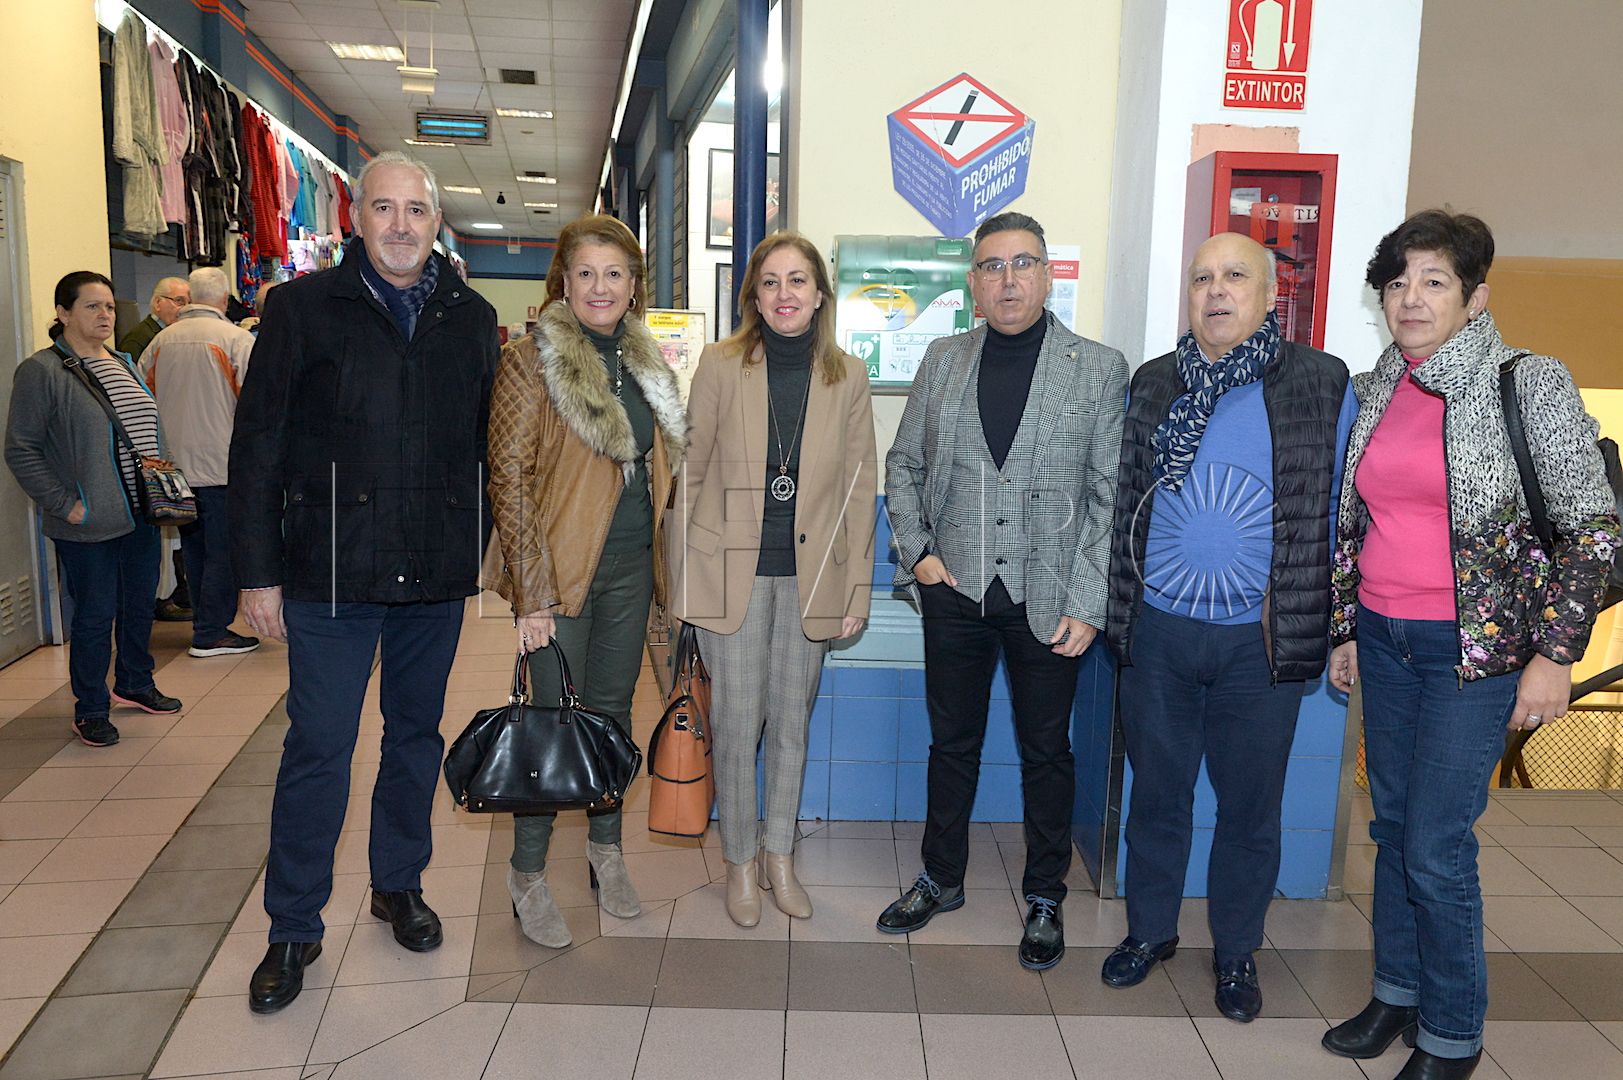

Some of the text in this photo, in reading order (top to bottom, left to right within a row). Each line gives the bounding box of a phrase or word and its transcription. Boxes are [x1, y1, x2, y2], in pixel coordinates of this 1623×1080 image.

[1225, 79, 1304, 103] EXTINTOR
[961, 135, 1031, 200] PROHIBIDO
[973, 166, 1017, 213] FUMAR
